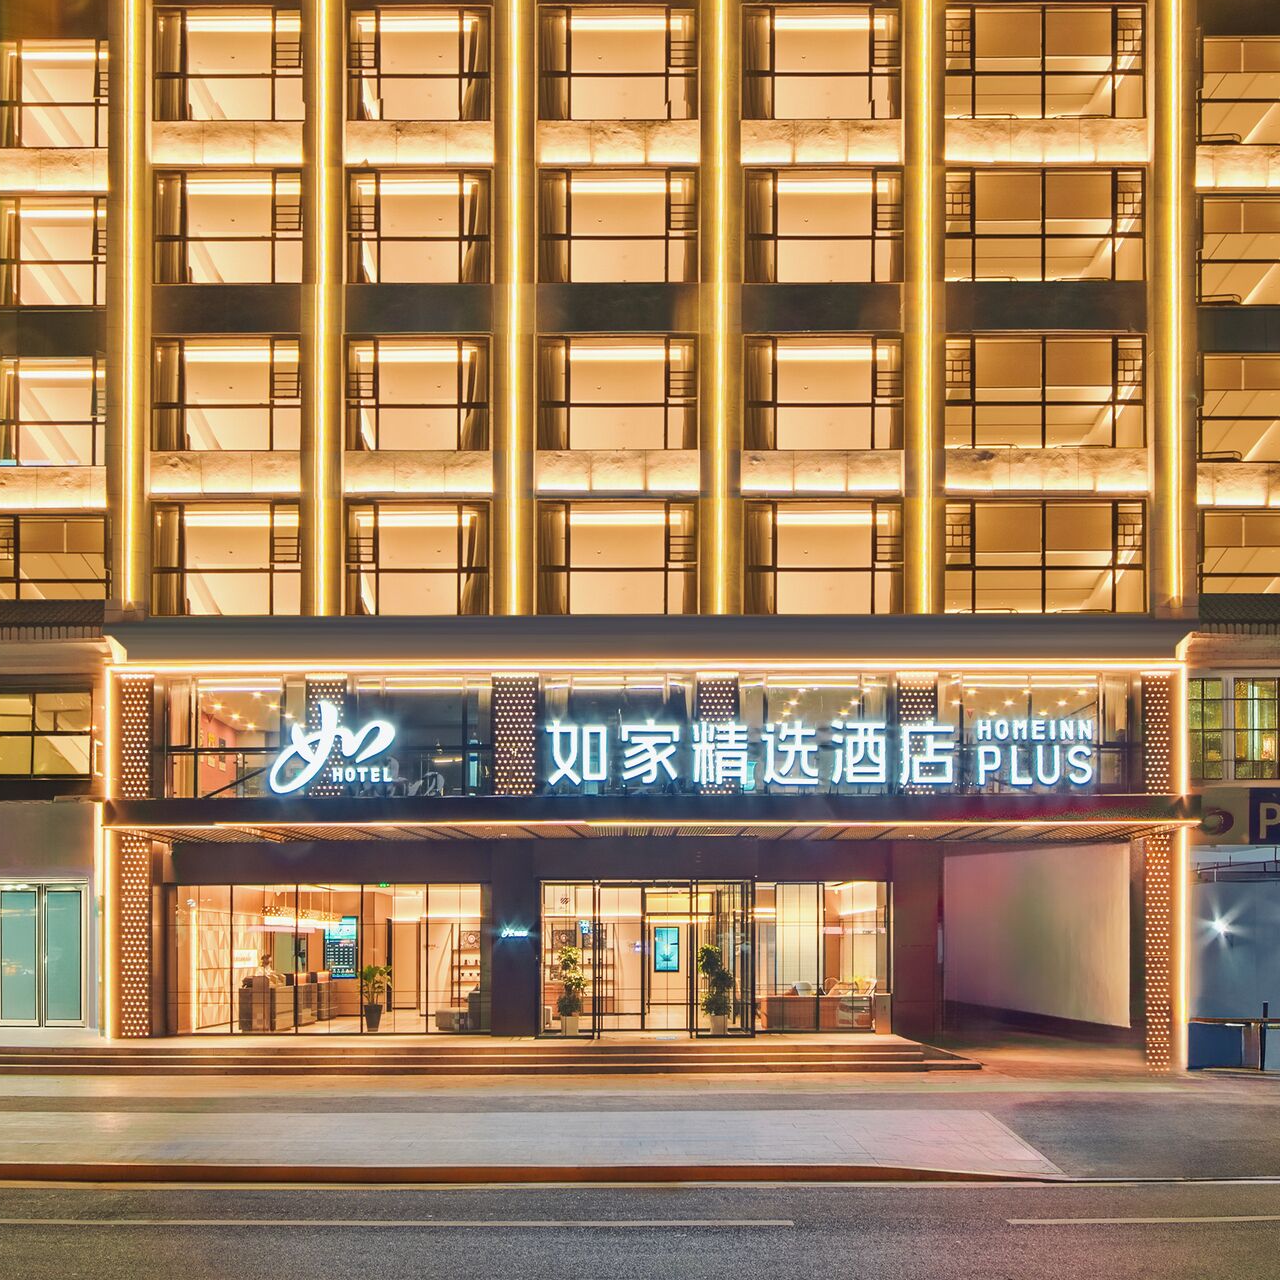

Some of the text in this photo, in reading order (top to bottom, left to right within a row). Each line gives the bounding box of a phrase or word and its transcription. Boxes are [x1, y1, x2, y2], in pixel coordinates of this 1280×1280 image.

[546, 719, 956, 786] 如家精选酒店
[977, 744, 1093, 785] PLUS
[332, 767, 393, 783] HOTEL
